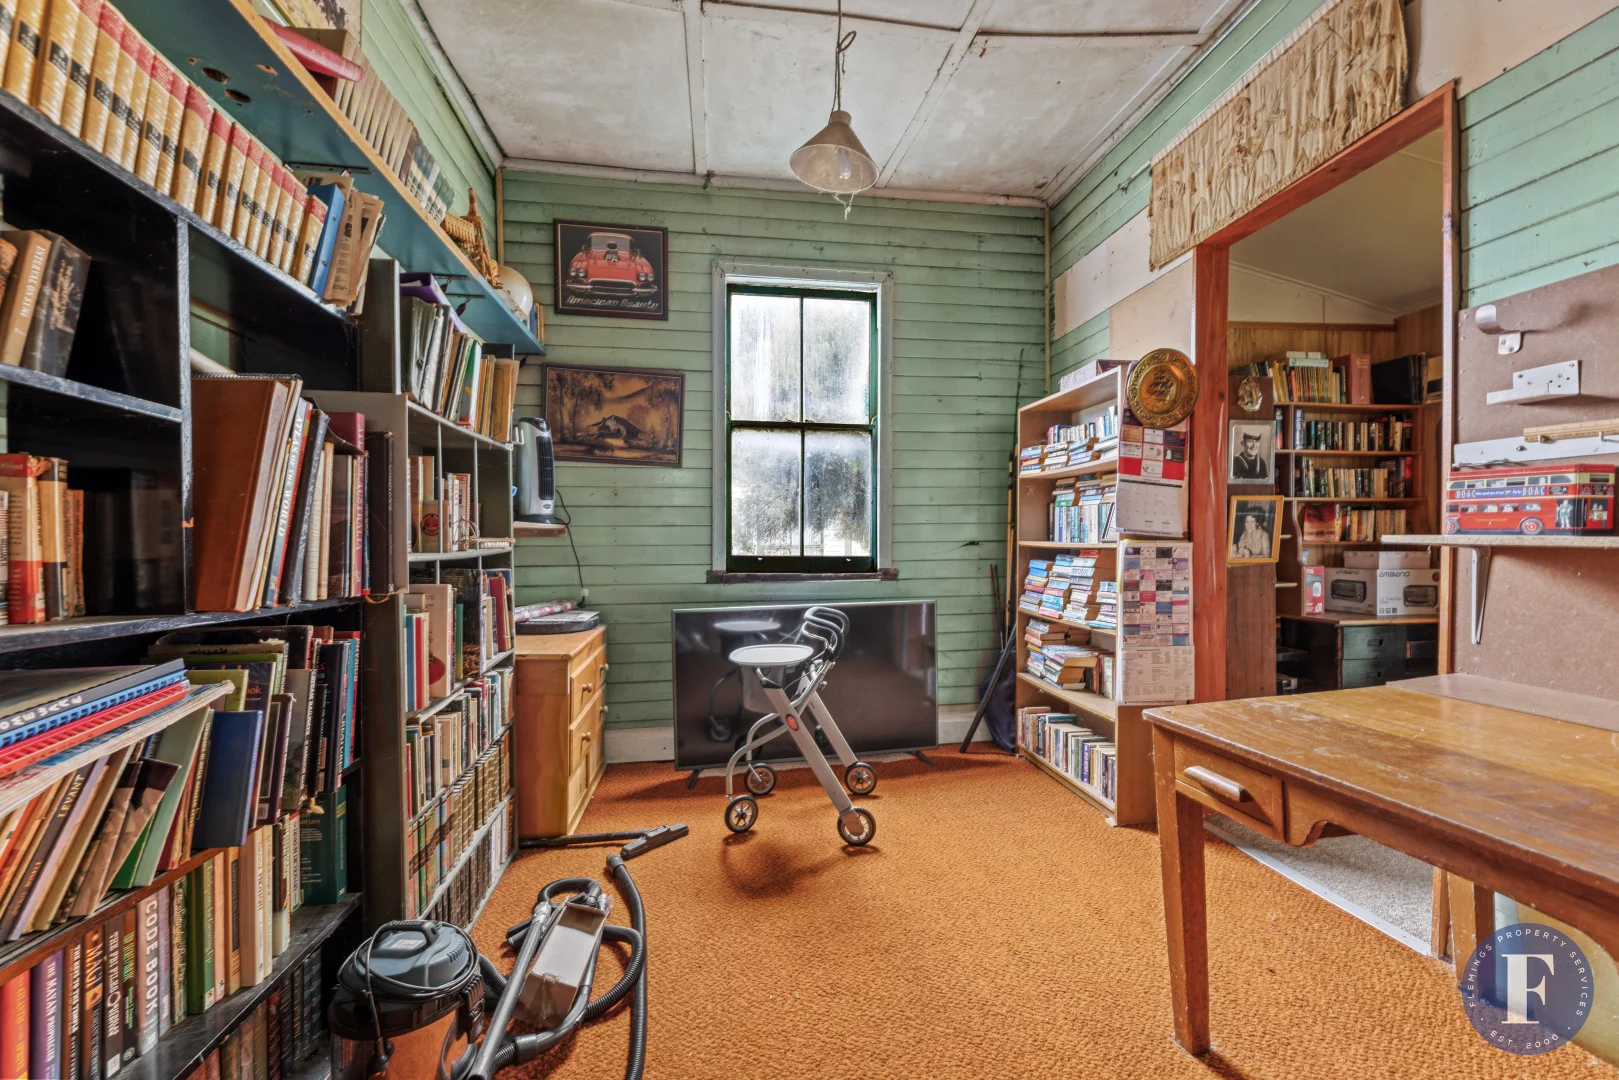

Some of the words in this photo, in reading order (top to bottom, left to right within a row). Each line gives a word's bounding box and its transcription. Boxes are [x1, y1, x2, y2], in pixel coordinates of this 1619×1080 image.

[28, 246, 46, 284] INTERVAL
[26, 284, 36, 296] ON
[566, 294, 618, 306] American
[620, 298, 660, 310] Beauty
[292, 416, 303, 453] ATLAS
[290, 454, 298, 467] OF
[278, 489, 292, 537] WORLD
[201, 722, 212, 752] CORNWALL
[196, 761, 205, 779] STEAM
[57, 774, 85, 818] LEVANT
[191, 780, 202, 809] WESTERN
[204, 866, 213, 906] Guideposts
[109, 931, 119, 952] THE
[146, 899, 158, 955] CODE
[205, 918, 213, 952] Growing
[72, 944, 80, 960] THE
[85, 943, 103, 989] MAGI
[109, 950, 119, 969] FBI
[205, 952, 213, 964] Up
[47, 961, 56, 978] THE
[72, 978, 80, 988] TO
[109, 966, 119, 994] FILES
[46, 977, 57, 1017] MAYAN
[146, 956, 158, 1016] BOOK
[16, 987, 26, 1024] ATLANTIS
[45, 1016, 56, 1062] PROPHECIES
[15, 1041, 25, 1072] SPHINX
